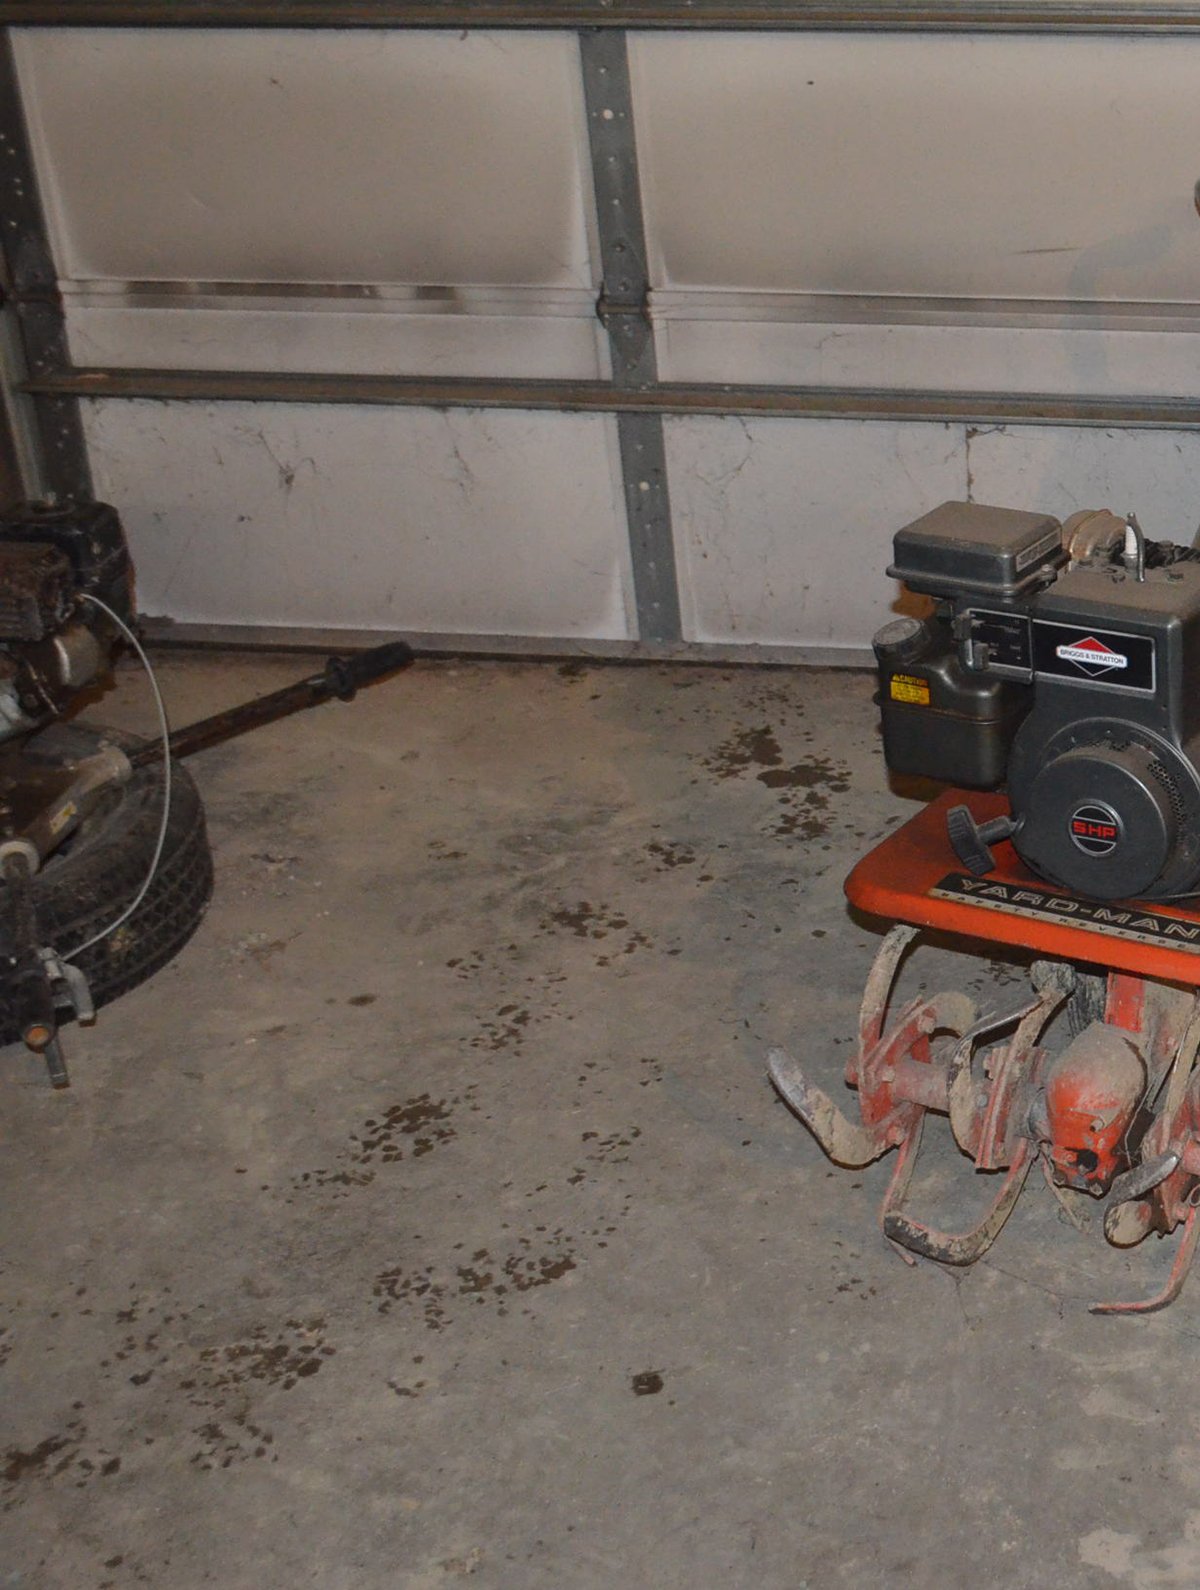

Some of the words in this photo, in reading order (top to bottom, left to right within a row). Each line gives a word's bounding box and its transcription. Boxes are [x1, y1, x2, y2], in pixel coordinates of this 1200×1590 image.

[1059, 648, 1085, 659] BRIGGS
[1091, 654, 1124, 665] STRATTON
[960, 878, 1200, 940] YARD-MAN
[1058, 917, 1188, 949] REVERSE
